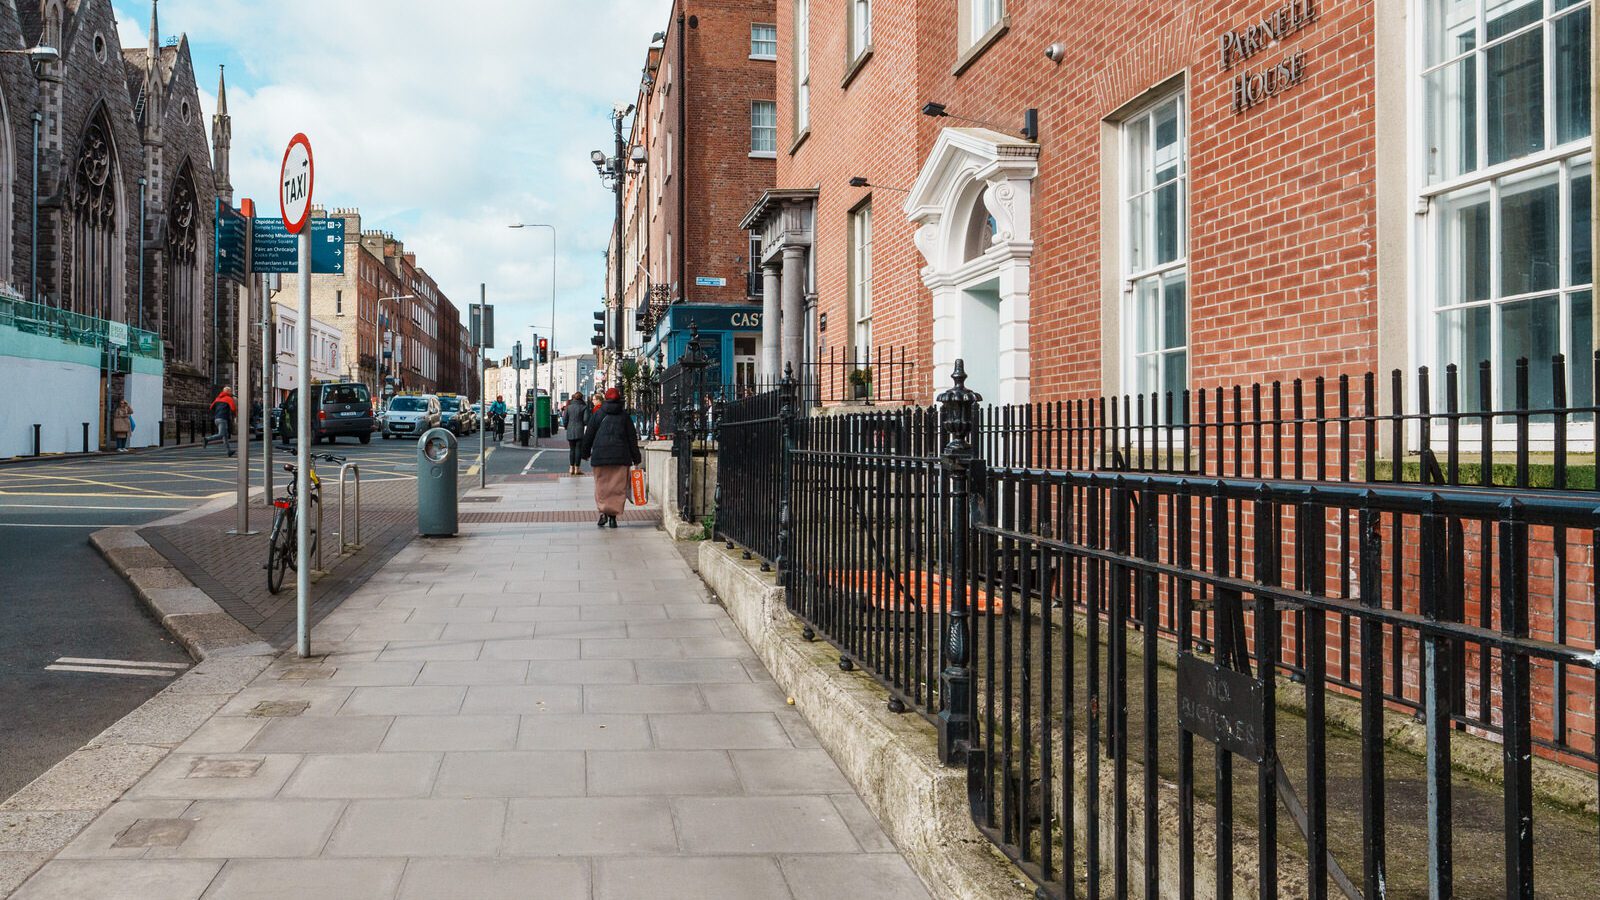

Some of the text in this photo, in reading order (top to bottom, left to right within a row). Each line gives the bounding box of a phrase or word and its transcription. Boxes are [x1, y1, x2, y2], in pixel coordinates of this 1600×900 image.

[1220, 0, 1316, 70] PARNELL
[1231, 49, 1307, 112] HOUSE
[285, 172, 306, 204] TAXI
